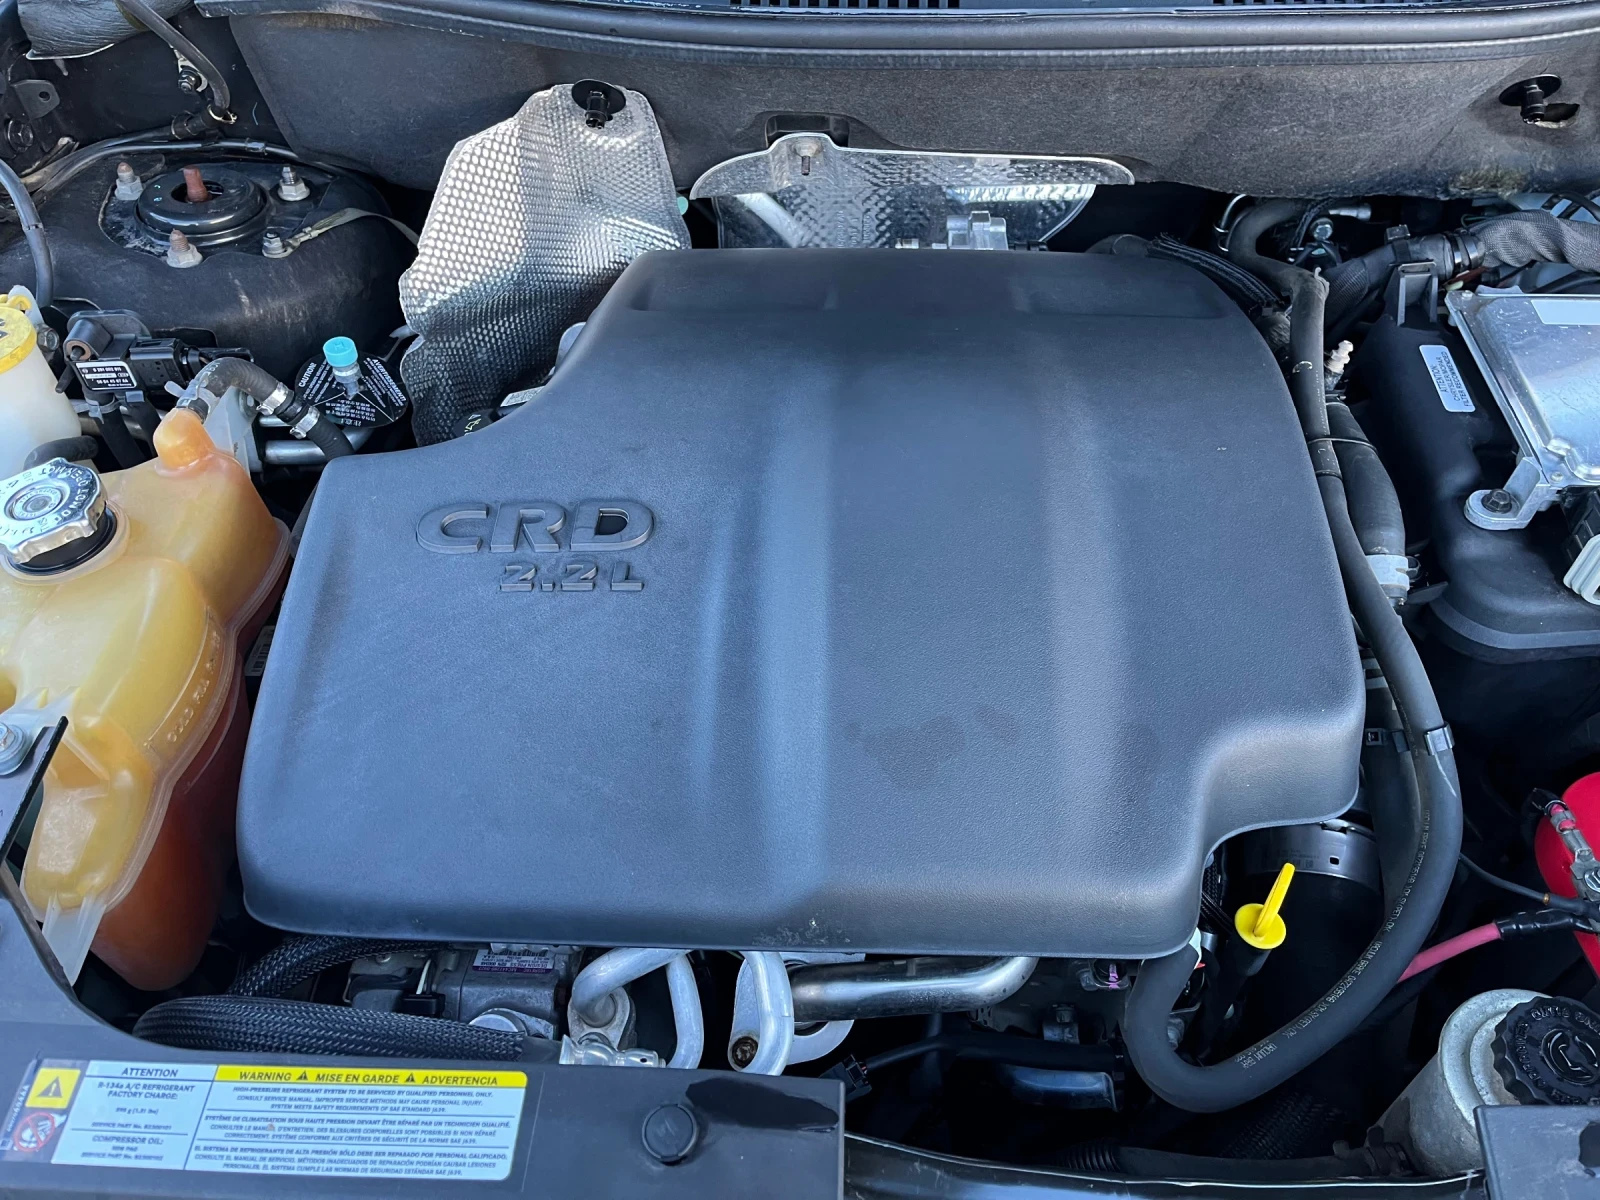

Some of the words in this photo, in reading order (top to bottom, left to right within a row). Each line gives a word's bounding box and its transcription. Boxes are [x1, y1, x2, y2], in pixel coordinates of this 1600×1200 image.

[1441, 352, 1462, 390] RECOMMENDED
[372, 359, 406, 402] AVERTISSEMENT!
[1458, 389, 1472, 406] FILTER
[416, 500, 655, 554] CRD
[122, 1067, 178, 1076] ATTENTION
[238, 1071, 292, 1080] WARNING
[315, 1073, 343, 1081] MISE
[345, 1074, 360, 1082] EN
[362, 1074, 399, 1083] GARDE
[421, 1075, 498, 1085] ADVERTENCIA
[142, 1083, 195, 1091] REFRIGERANT
[92, 1135, 147, 1143] COMPRESSOR
